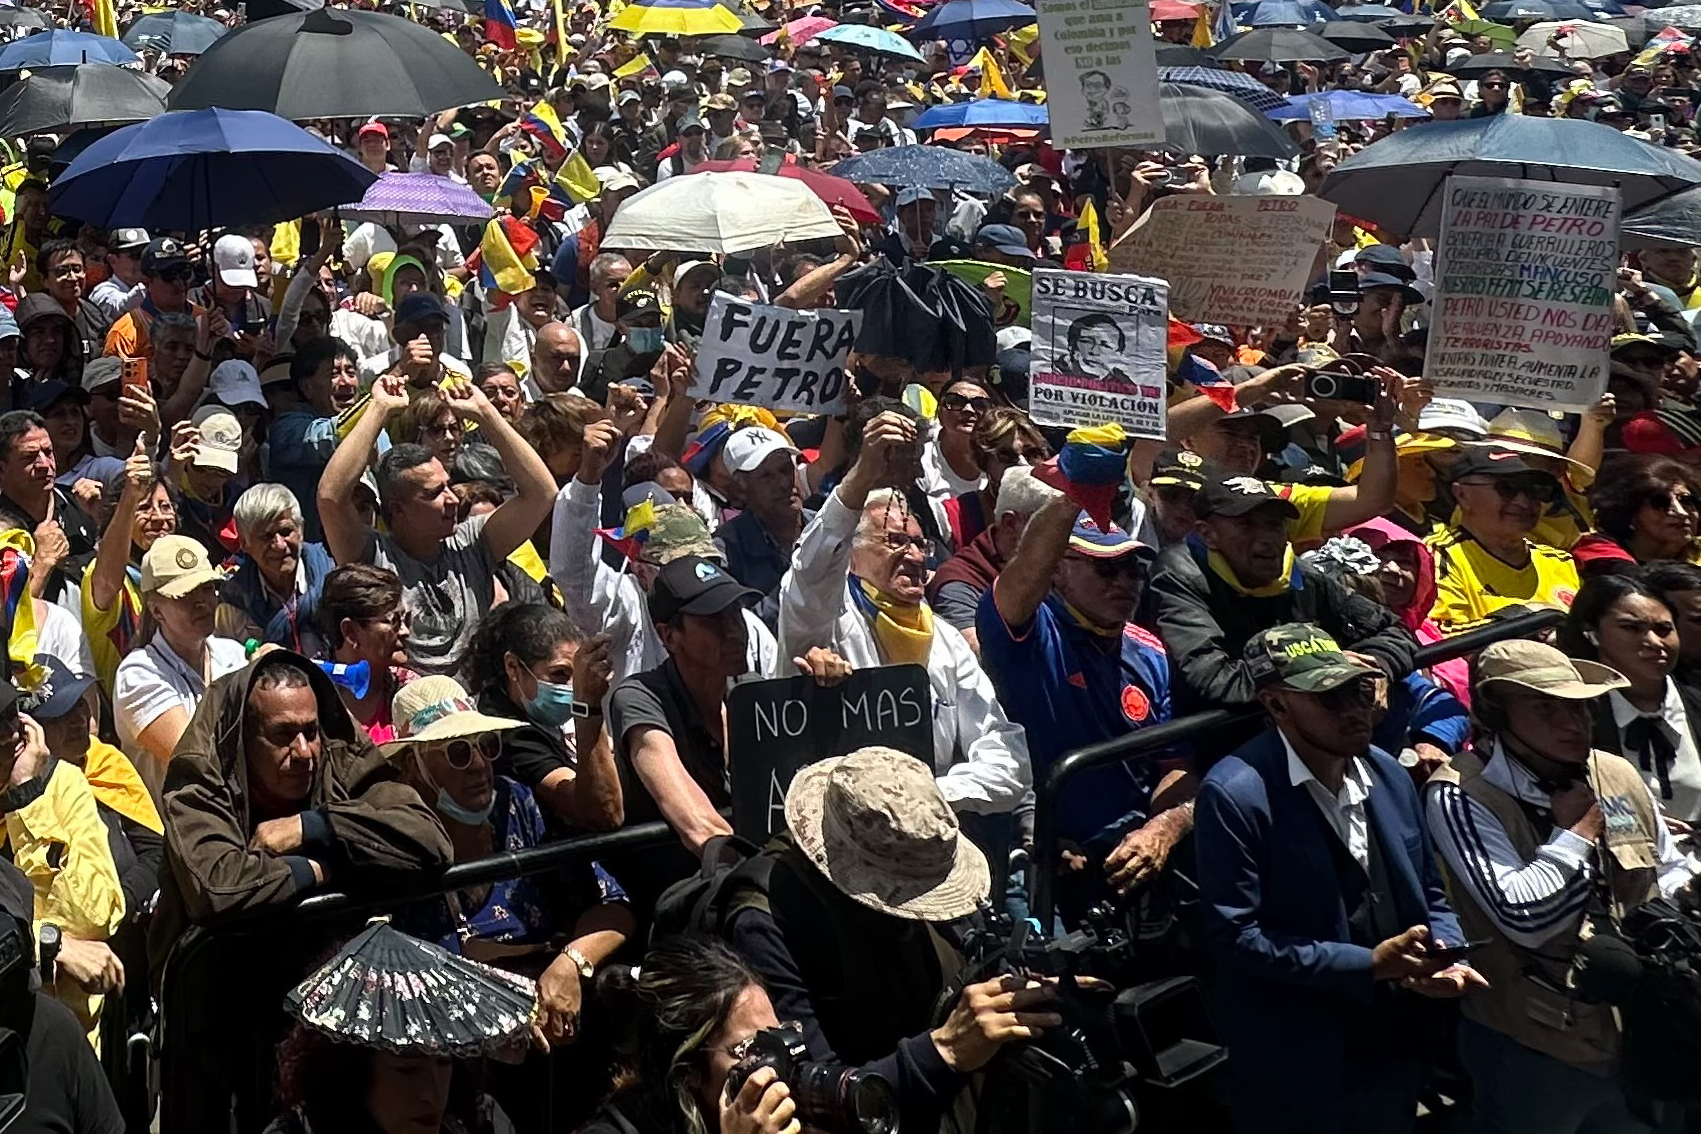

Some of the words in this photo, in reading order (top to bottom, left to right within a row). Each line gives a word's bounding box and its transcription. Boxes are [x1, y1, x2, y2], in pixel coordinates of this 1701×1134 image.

[1054, 25, 1106, 41] Colombia
[1117, 25, 1138, 36] por
[1064, 15, 1086, 27] que
[1064, 44, 1083, 55] eso
[1085, 39, 1131, 53] decimos
[1256, 199, 1300, 212] PETRO
[1491, 189, 1536, 211] MUNDO
[1537, 193, 1556, 213] SE
[1556, 197, 1616, 219] ENTERE
[1451, 210, 1472, 227] LA
[1500, 212, 1525, 230] DE
[1527, 213, 1606, 237] PETRO
[1510, 235, 1617, 257] GUERRILLEROS
[1518, 264, 1605, 287] MANCUSO
[1036, 276, 1067, 296] SE
[1073, 279, 1158, 306] BUSCA
[1236, 286, 1301, 301] COLOMBIA
[1522, 280, 1546, 301] SE
[1441, 297, 1484, 318] PETRO
[1486, 300, 1541, 322] USTED
[1541, 307, 1578, 329] NOS
[719, 302, 857, 365] FUERA
[1530, 328, 1612, 353] APOYANDO
[708, 356, 842, 406] PETRO
[1579, 365, 1601, 379] LA
[1034, 386, 1065, 402] POR
[1070, 391, 1159, 415] VIOLACIÓN
[754, 699, 808, 742] NO
[840, 686, 922, 732] MAS
